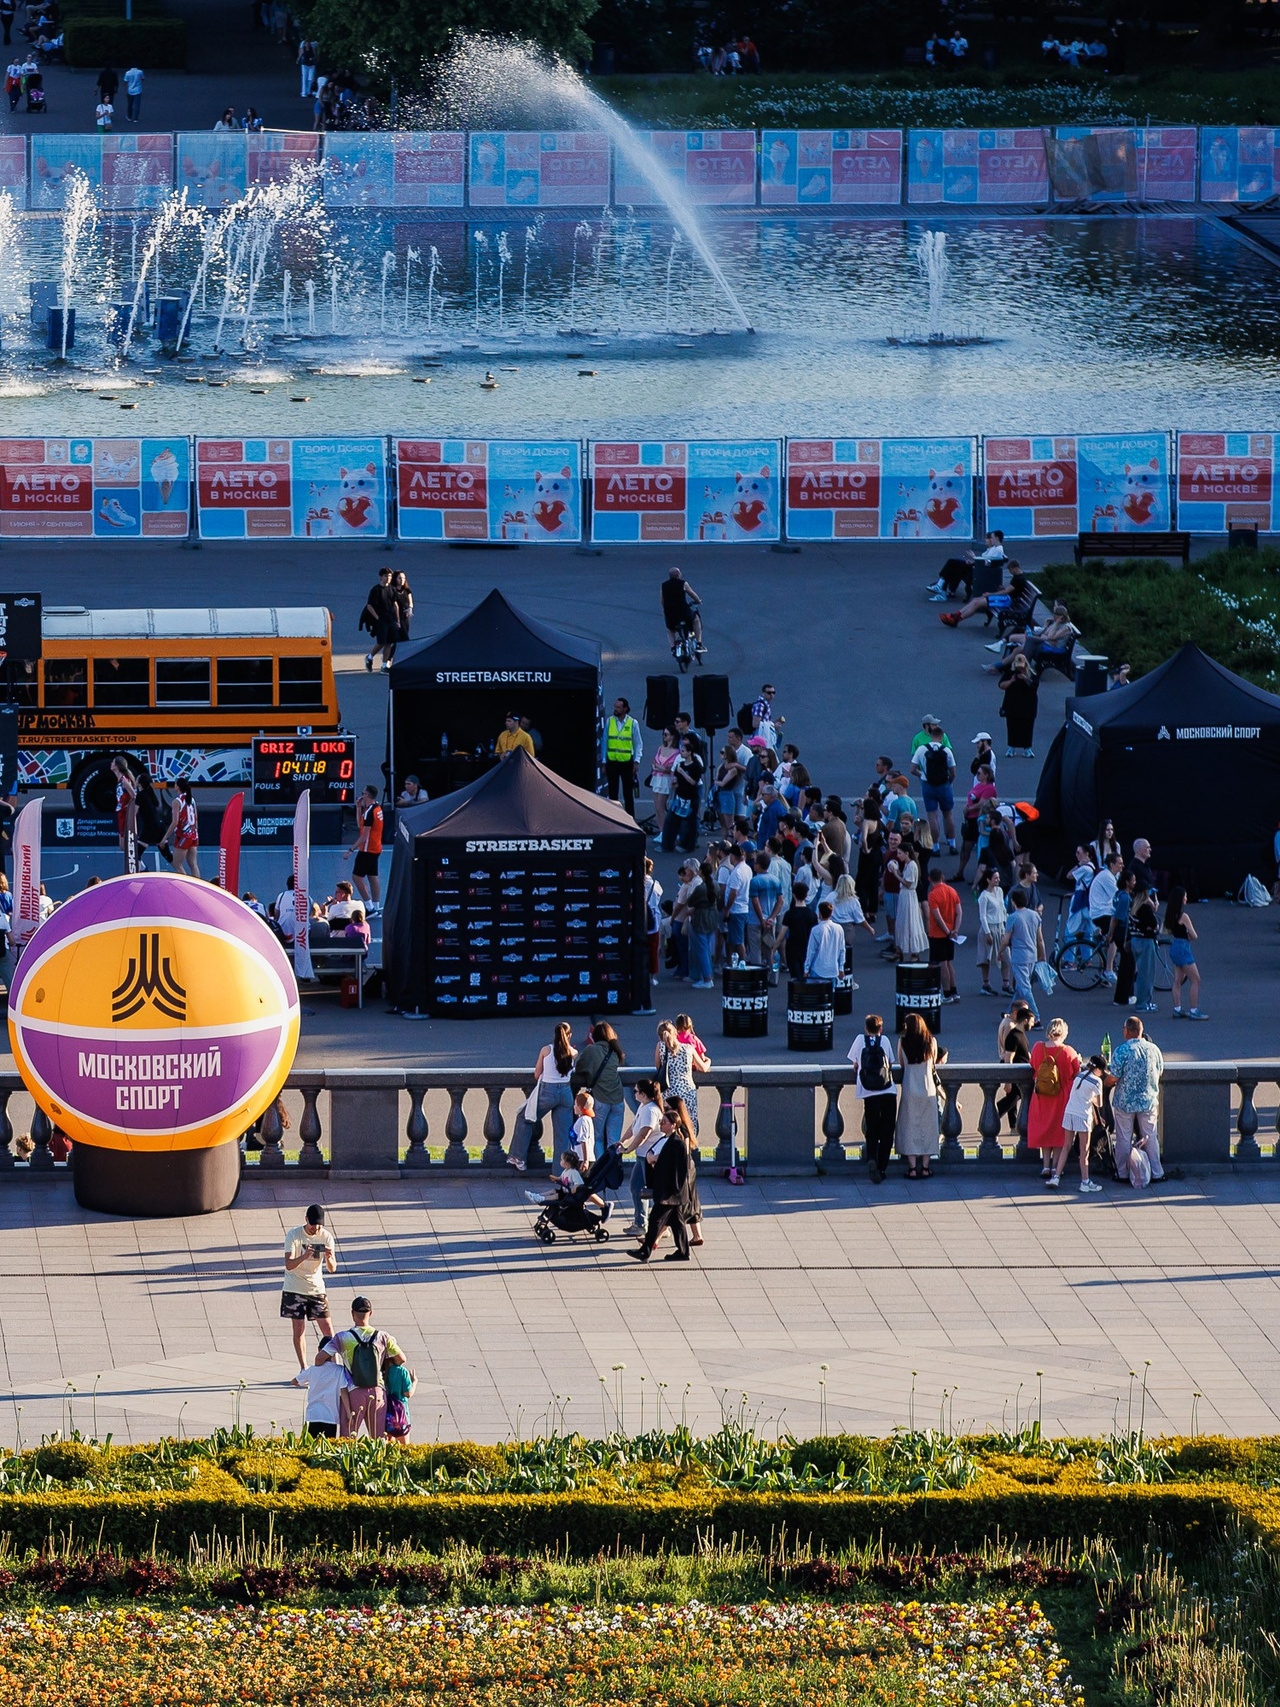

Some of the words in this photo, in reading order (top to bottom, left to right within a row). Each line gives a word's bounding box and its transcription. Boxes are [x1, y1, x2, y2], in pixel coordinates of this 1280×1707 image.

[211, 470, 278, 488] ЛЕТО
[410, 471, 475, 489] ЛЕТО
[801, 470, 867, 488] ЛЕТО
[999, 468, 1064, 486] ЛЕТО
[1192, 464, 1259, 482] ЛЕТО
[13, 474, 80, 491] ЛЕТО
[607, 473, 673, 490] ЛЕТО
[210, 491, 219, 499] В
[223, 491, 277, 500] МОСКВЕ
[409, 490, 418, 500] В
[422, 491, 475, 500] МОСКВЕ
[800, 492, 808, 500] В
[813, 491, 866, 500] МОСКВЕ
[998, 490, 1006, 499] В
[1011, 489, 1064, 499] МОСКВЕ
[1191, 484, 1199, 493] В
[1204, 484, 1258, 494] МОСКВЕ
[12, 494, 20, 502] В
[25, 494, 80, 503] МОСКВЕ
[606, 494, 615, 502] В
[619, 494, 673, 502] МОСКВЕ
[436, 670, 552, 684] STREETBASKET.RU
[1176, 724, 1232, 740] МОСКОВСКИЙ
[1234, 727, 1261, 738] СПОРТ
[18, 736, 137, 744] T.RU/STREETBASKET-TOUR
[260, 742, 294, 754] GRIZ
[312, 742, 346, 754] LOKO
[340, 760, 353, 778] 0
[254, 782, 280, 790] FOULS
[257, 818, 294, 826] МОСКОВСКИ
[257, 826, 278, 836] СПОРТ
[466, 838, 594, 852] STREETBASKET
[78, 1046, 221, 1080] МОСКОВСКИЙ
[116, 1086, 183, 1110] СПОРТ
